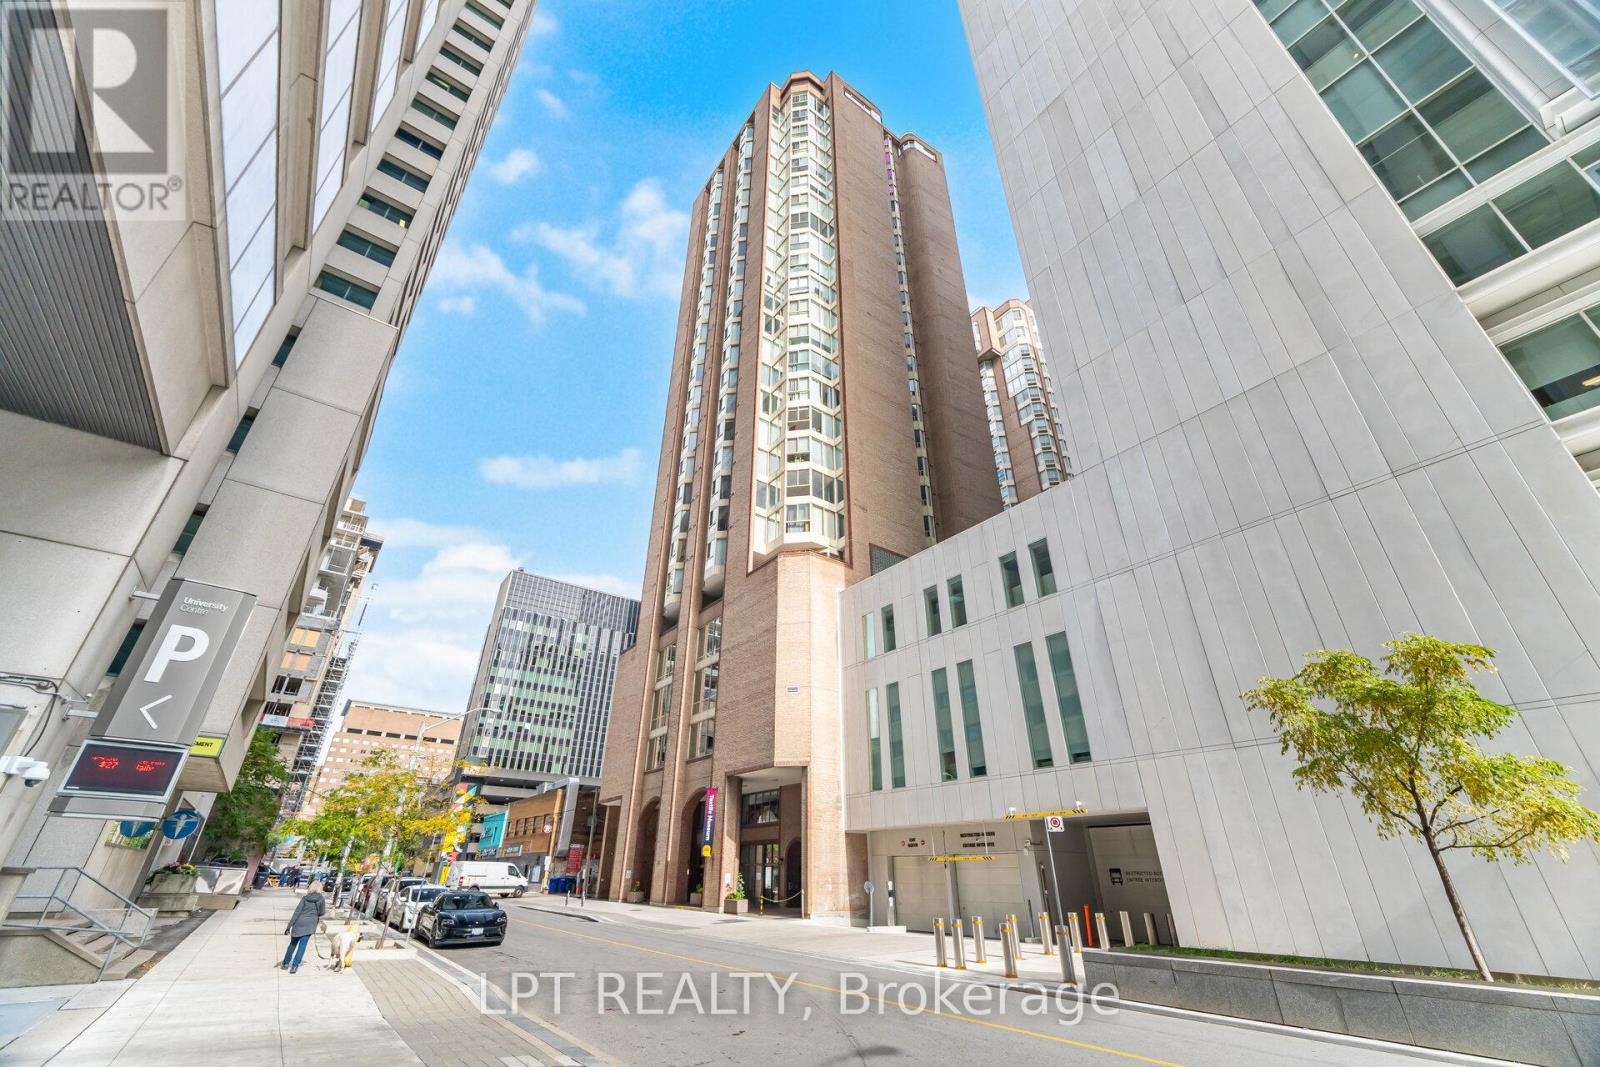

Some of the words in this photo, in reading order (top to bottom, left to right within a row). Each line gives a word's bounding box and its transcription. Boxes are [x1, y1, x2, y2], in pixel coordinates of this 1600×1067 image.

[183, 596, 229, 612] University
[143, 624, 210, 683] P
[705, 815, 713, 841] Museum
